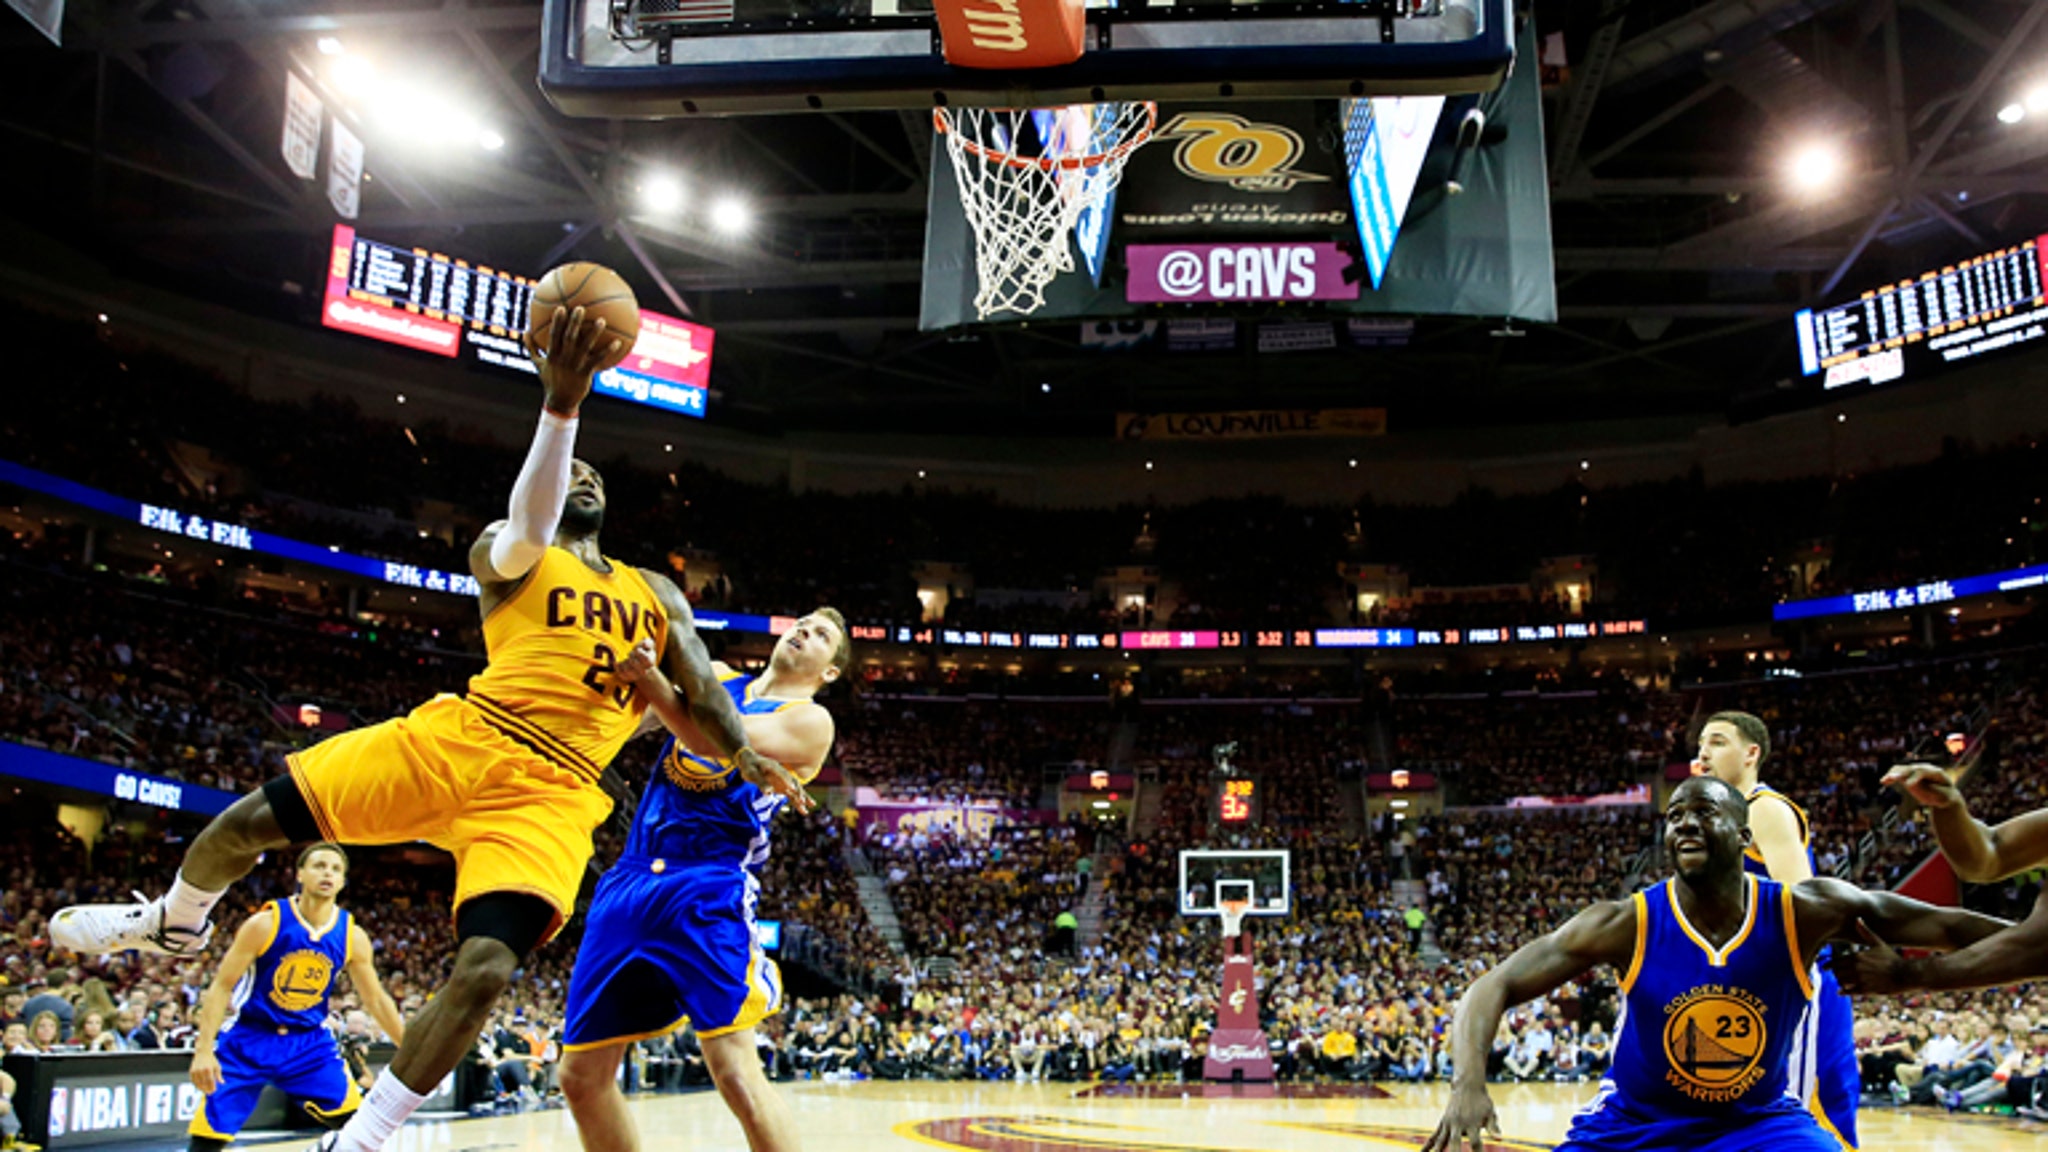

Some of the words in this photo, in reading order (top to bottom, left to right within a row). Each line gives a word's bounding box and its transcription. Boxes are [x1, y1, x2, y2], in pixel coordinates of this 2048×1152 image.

[1122, 213, 1216, 225] Loans
[1191, 203, 1281, 213] Arena
[1221, 210, 1348, 225] Quicken
[1157, 247, 1316, 298] @CAVS
[599, 366, 651, 401] drug
[650, 383, 702, 409] mart
[140, 503, 182, 534] Elk
[185, 515, 209, 540] &
[212, 521, 253, 550] Elk
[385, 562, 423, 588] Elk
[425, 569, 447, 591] &
[1853, 589, 1893, 612] Elk
[1895, 586, 1916, 608] &
[1917, 579, 1956, 604] Elk
[546, 585, 660, 643] CAVS
[114, 772, 137, 801] GO
[303, 966, 324, 983] 30
[1663, 983, 1724, 1014] GOLDEN
[1728, 985, 1769, 1015] STATE
[1716, 1015, 1751, 1039] 23
[1665, 1066, 1766, 1103] WARRIORS
[71, 1086, 129, 1132] NBA
